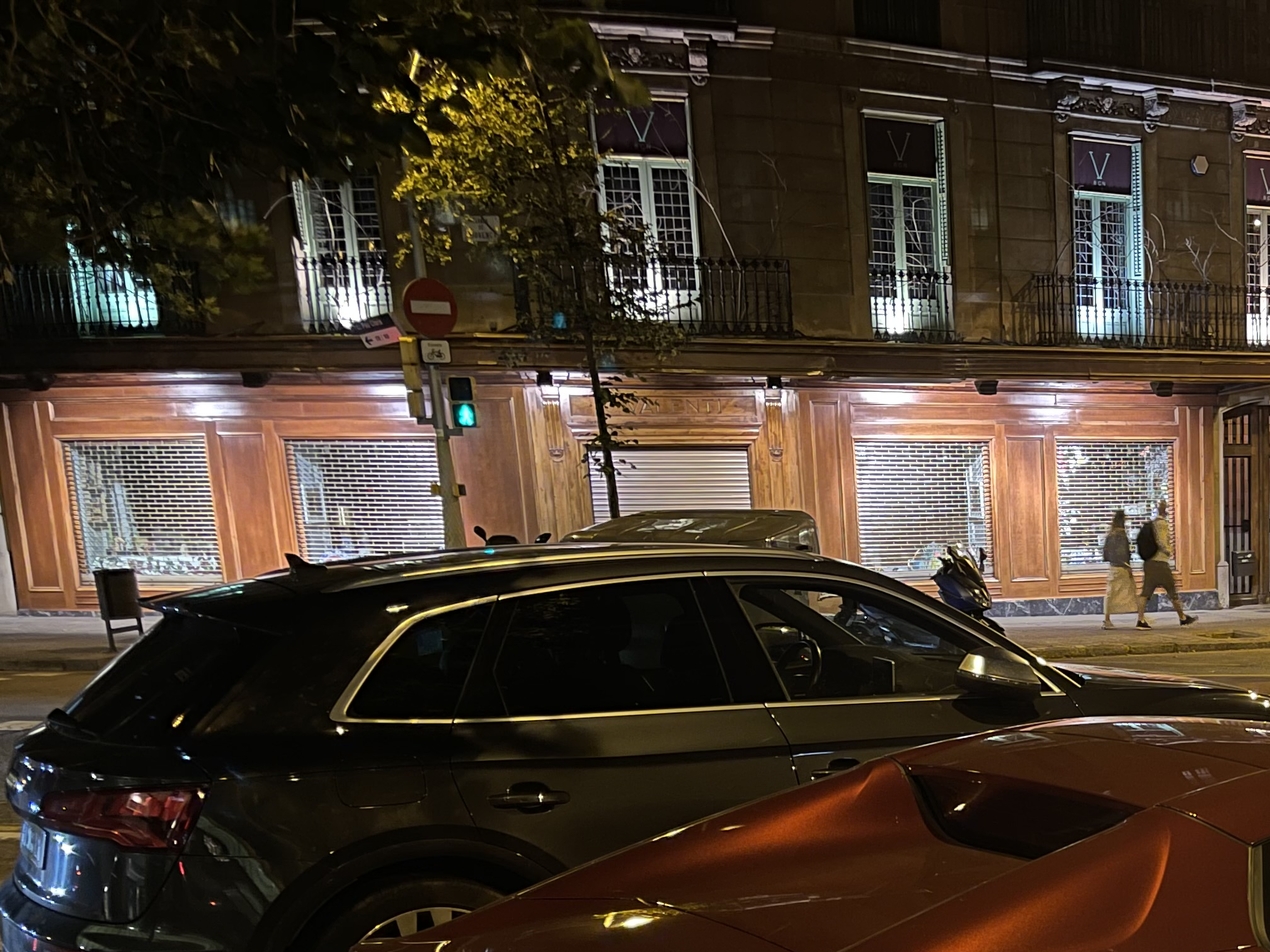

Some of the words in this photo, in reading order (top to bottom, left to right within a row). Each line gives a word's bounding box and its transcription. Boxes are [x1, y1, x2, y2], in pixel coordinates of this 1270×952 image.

[626, 110, 655, 142] V
[887, 130, 911, 161] V
[1088, 151, 1111, 180] V
